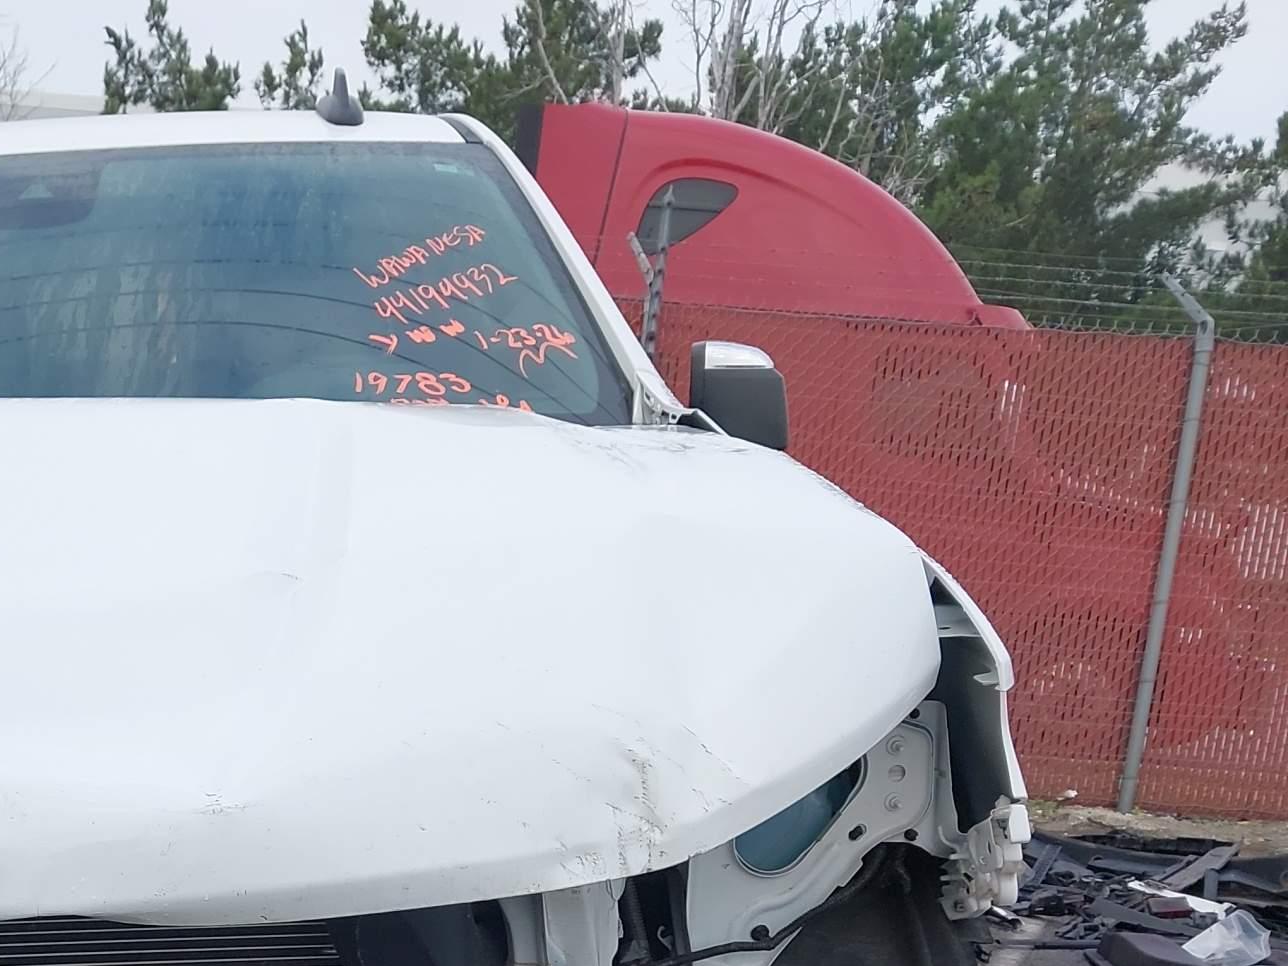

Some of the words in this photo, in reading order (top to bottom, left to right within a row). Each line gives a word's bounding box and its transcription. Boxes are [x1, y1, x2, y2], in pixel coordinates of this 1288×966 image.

[353, 224, 485, 288] WAWANESA
[374, 263, 518, 324] 44194932
[354, 371, 472, 396] 19783
